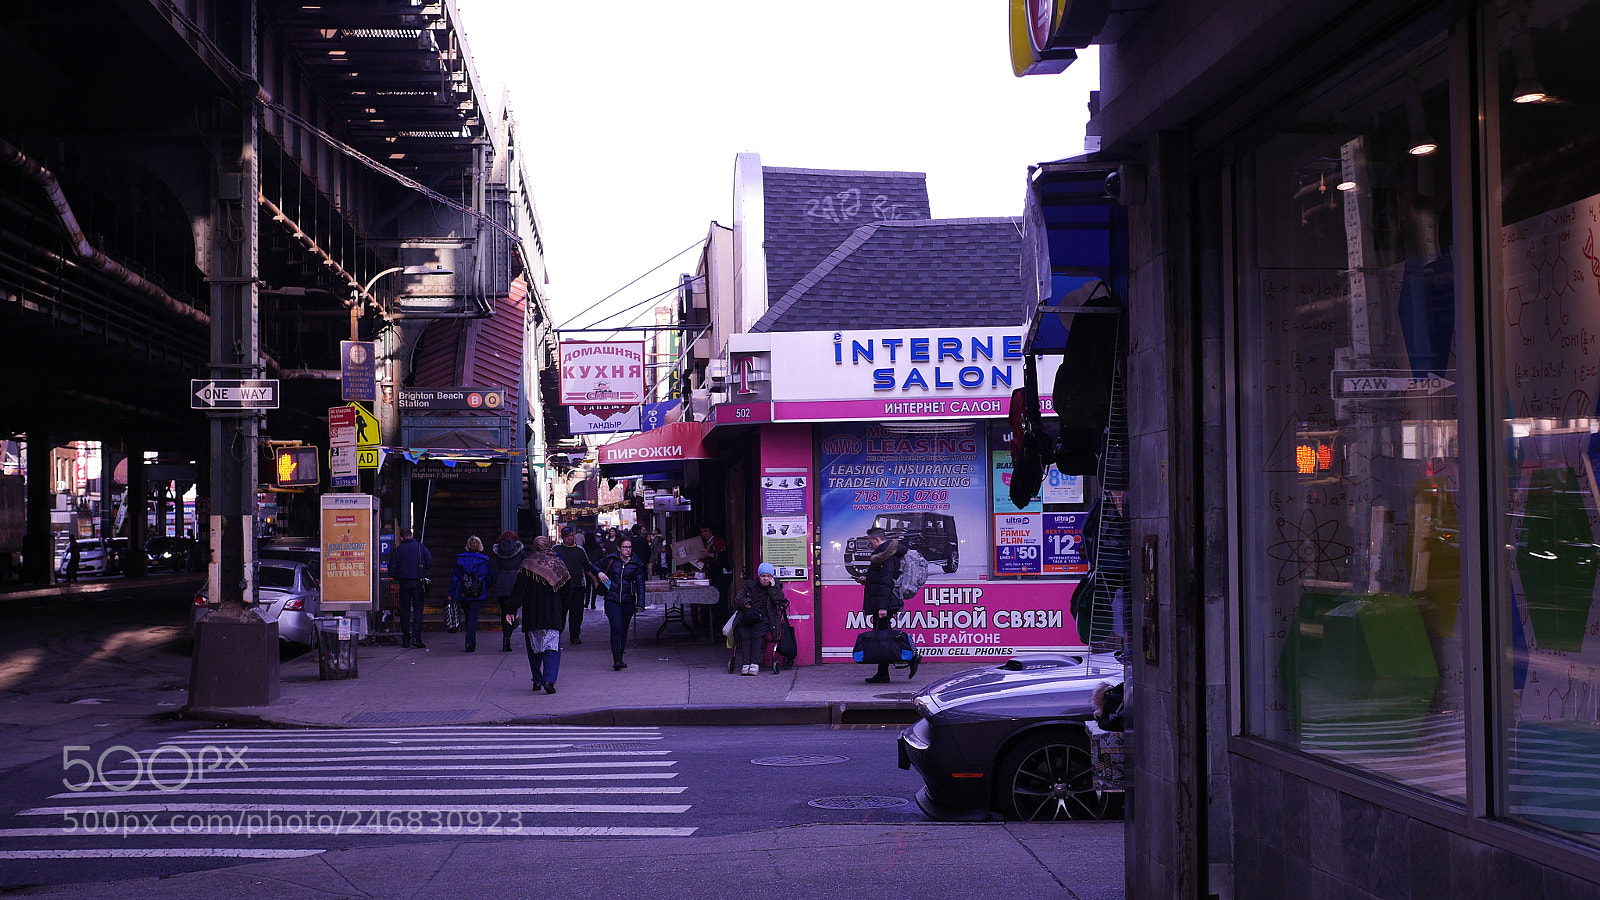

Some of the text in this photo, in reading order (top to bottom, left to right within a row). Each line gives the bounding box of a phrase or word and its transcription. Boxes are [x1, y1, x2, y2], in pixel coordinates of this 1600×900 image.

[563, 346, 641, 364] ДОМАШНЯЯ
[563, 365, 641, 379] КУХНЯ
[872, 364, 1012, 391] SALON
[204, 388, 267, 400] ONE WAY
[398, 391, 464, 401] Brighton Beach
[398, 399, 430, 408] Station
[471, 395, 479, 405] B
[488, 395, 497, 405] Q
[1037, 399, 1053, 410] 18
[884, 399, 1001, 415] ИНТЕРНЕТ САЛОН
[735, 407, 750, 419] 502
[588, 421, 622, 430] ТАНДЫР
[867, 439, 977, 454] LEASING
[358, 452, 374, 464] AD
[607, 445, 683, 460] ПИРОЖКИ
[830, 464, 968, 475] LEASING INSURANCE
[828, 477, 971, 488] TRADE-IN FINANCING
[1049, 469, 1060, 487] 8
[854, 490, 948, 502] 718 715 0760
[852, 503, 951, 511] www.mostwantedleasing.com
[1006, 516, 1022, 524] ultra
[1000, 529, 1031, 537] FAMILY
[381, 542, 388, 552] P
[1002, 546, 1010, 556] 4
[327, 562, 366, 570] IS SAFE
[353, 569, 367, 577] US.
[924, 587, 984, 606] ЦЕНТР
[993, 609, 1063, 629] СВЯЗИ
[933, 630, 1001, 645] БРАЙТОНЕ
[915, 647, 1014, 656] GHTON CELL PHONES
